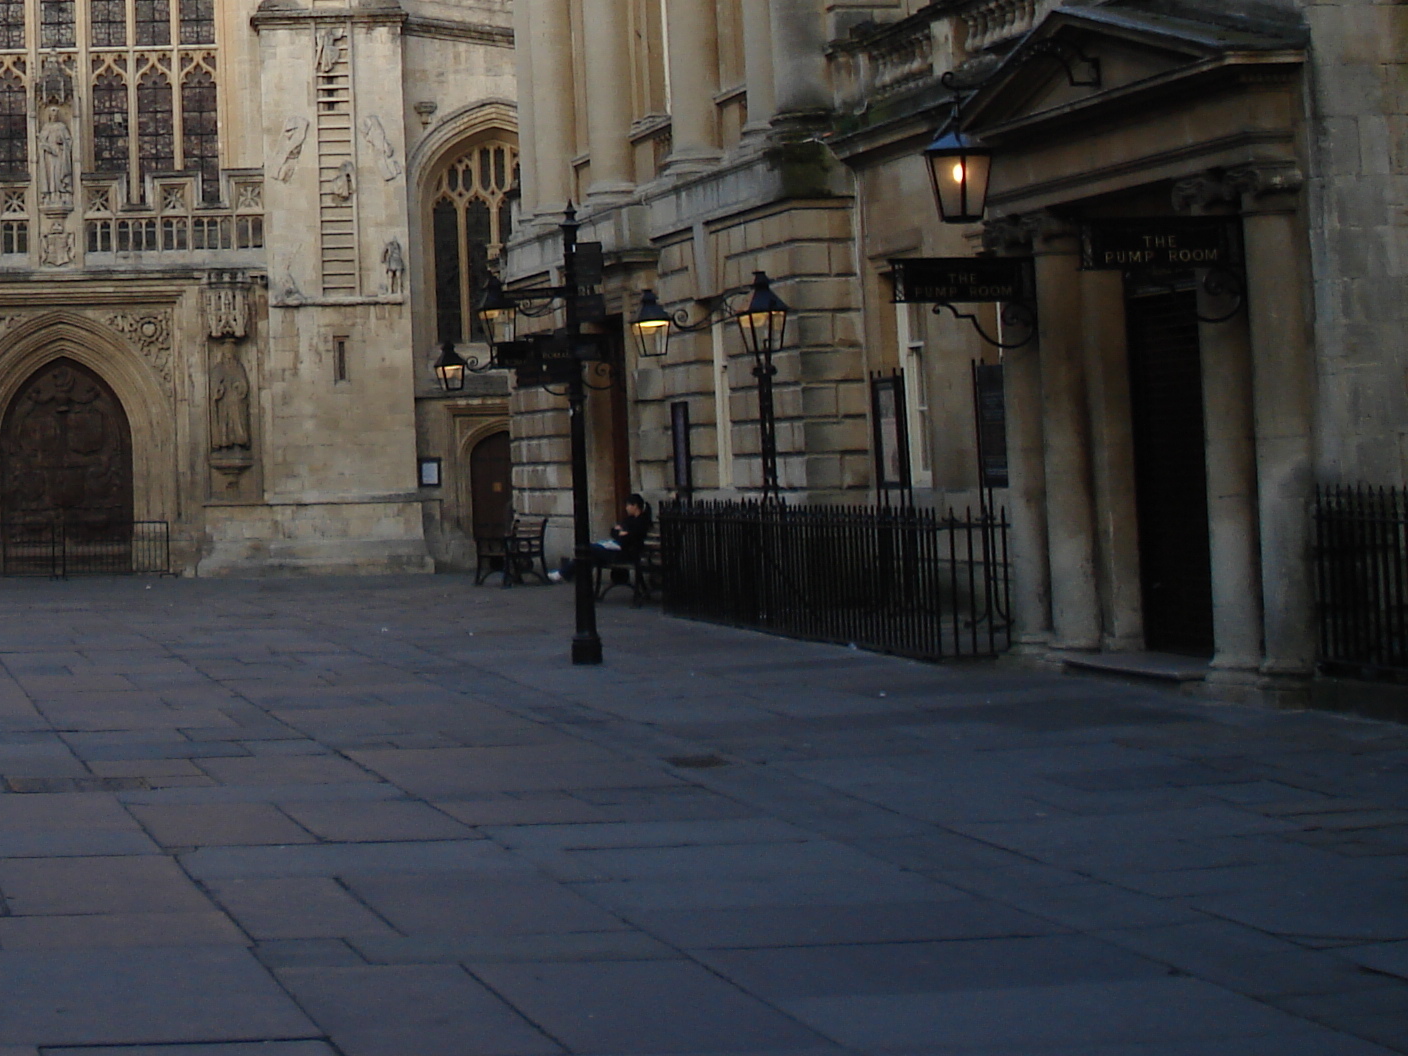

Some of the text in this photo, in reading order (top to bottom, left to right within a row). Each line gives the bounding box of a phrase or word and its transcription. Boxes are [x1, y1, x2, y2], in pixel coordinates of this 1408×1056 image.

[1141, 234, 1177, 248] THE
[1104, 247, 1218, 264] PUMP ROOM
[946, 272, 978, 285] THE
[914, 284, 1013, 299] PUMP ROOM
